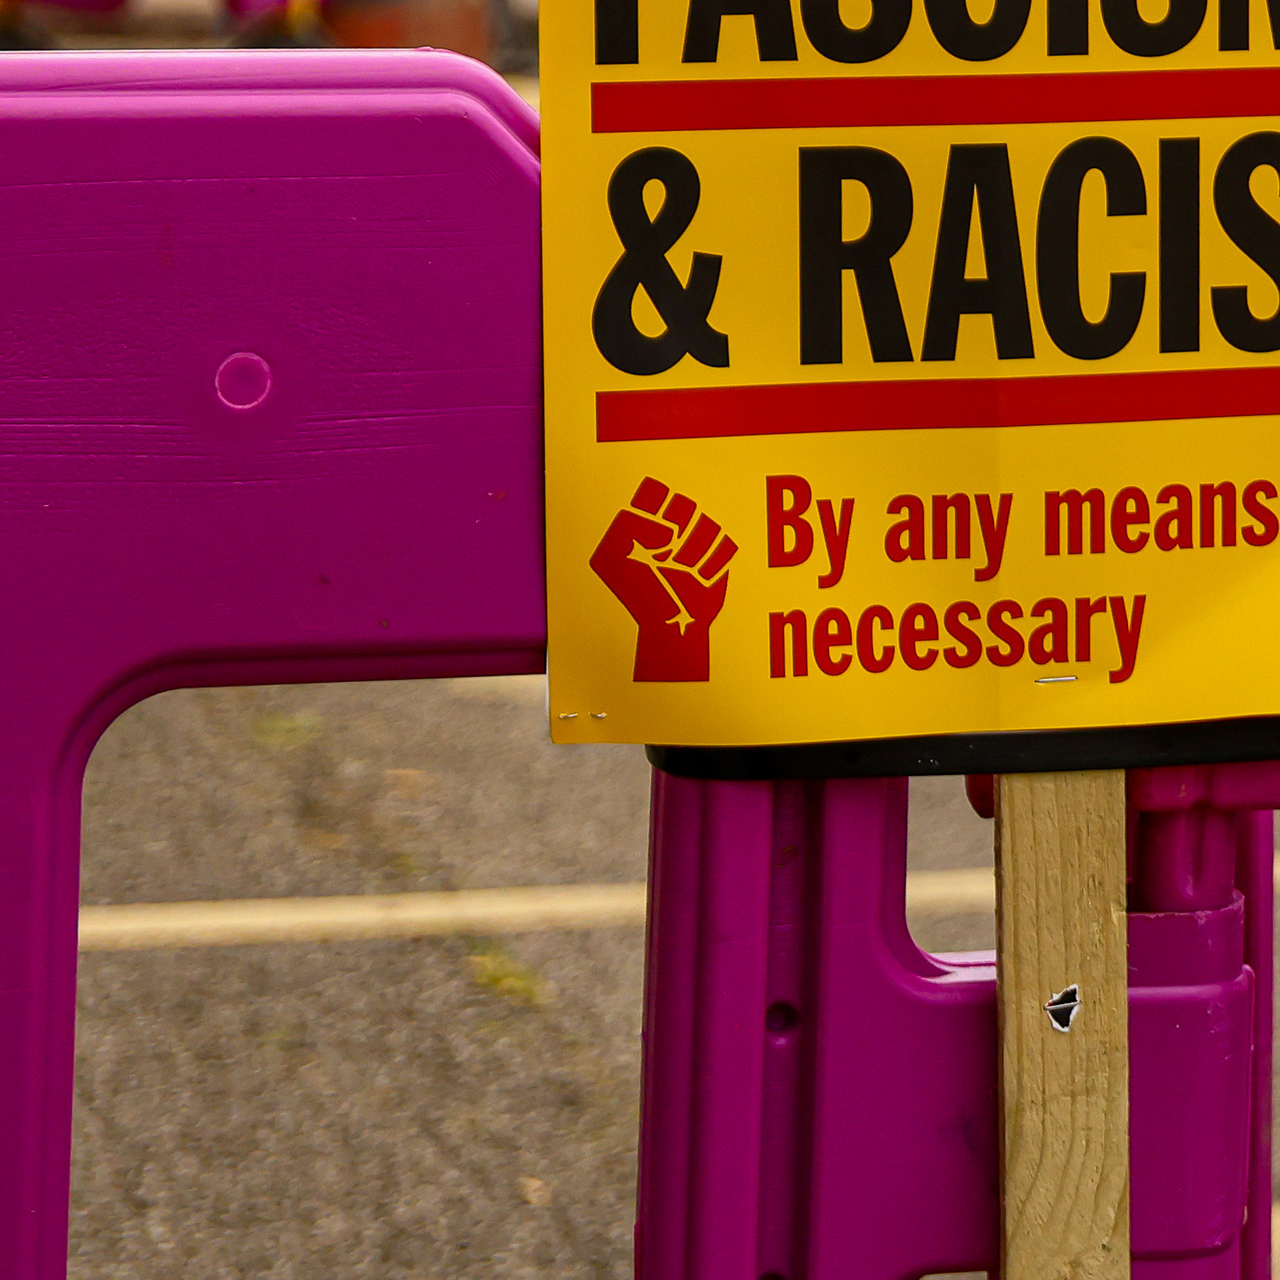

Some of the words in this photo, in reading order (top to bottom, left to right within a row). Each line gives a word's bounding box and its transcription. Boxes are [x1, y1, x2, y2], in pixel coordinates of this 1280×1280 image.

[591, 145, 731, 377] &
[765, 474, 855, 589] By
[884, 492, 1014, 583] any
[1044, 479, 1280, 556] means
[768, 594, 1147, 684] necessary
